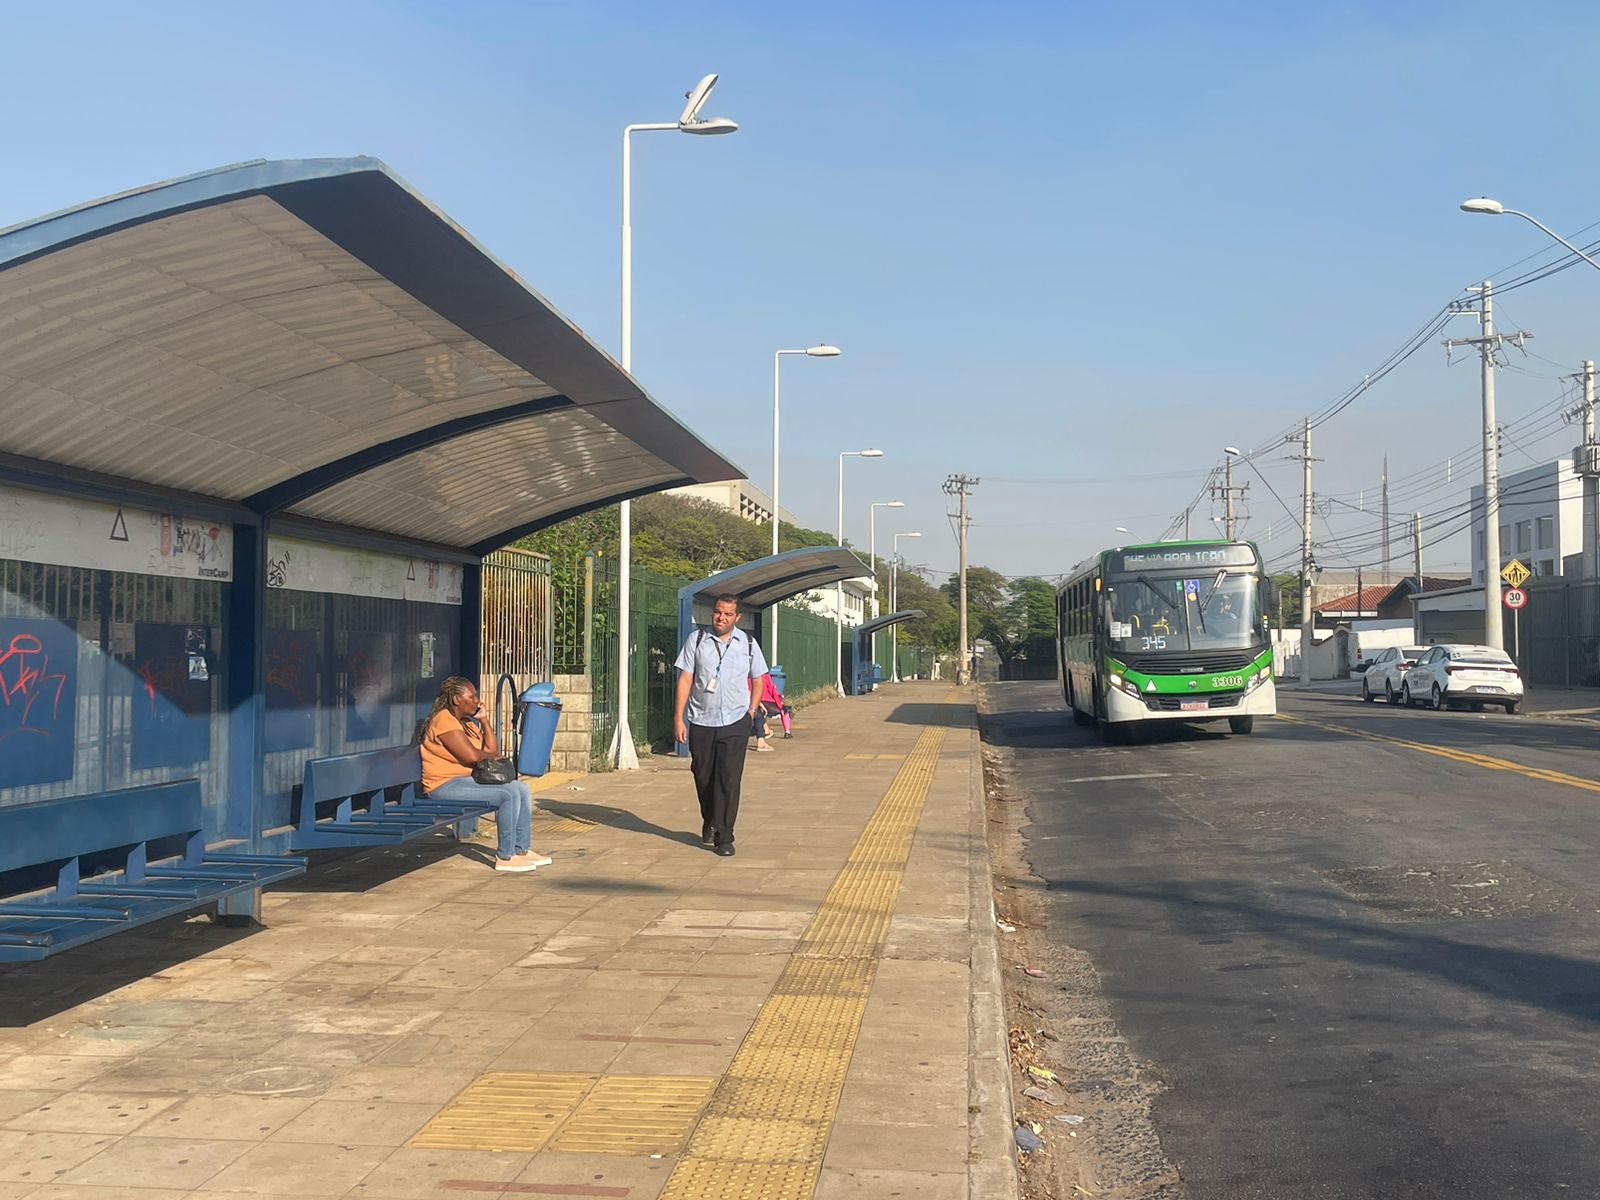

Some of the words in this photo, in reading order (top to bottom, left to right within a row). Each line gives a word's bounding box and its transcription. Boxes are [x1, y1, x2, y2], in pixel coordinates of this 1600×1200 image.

[1509, 592, 1521, 601] 30
[1142, 635, 1166, 650] 345
[1212, 676, 1242, 688] 3306
